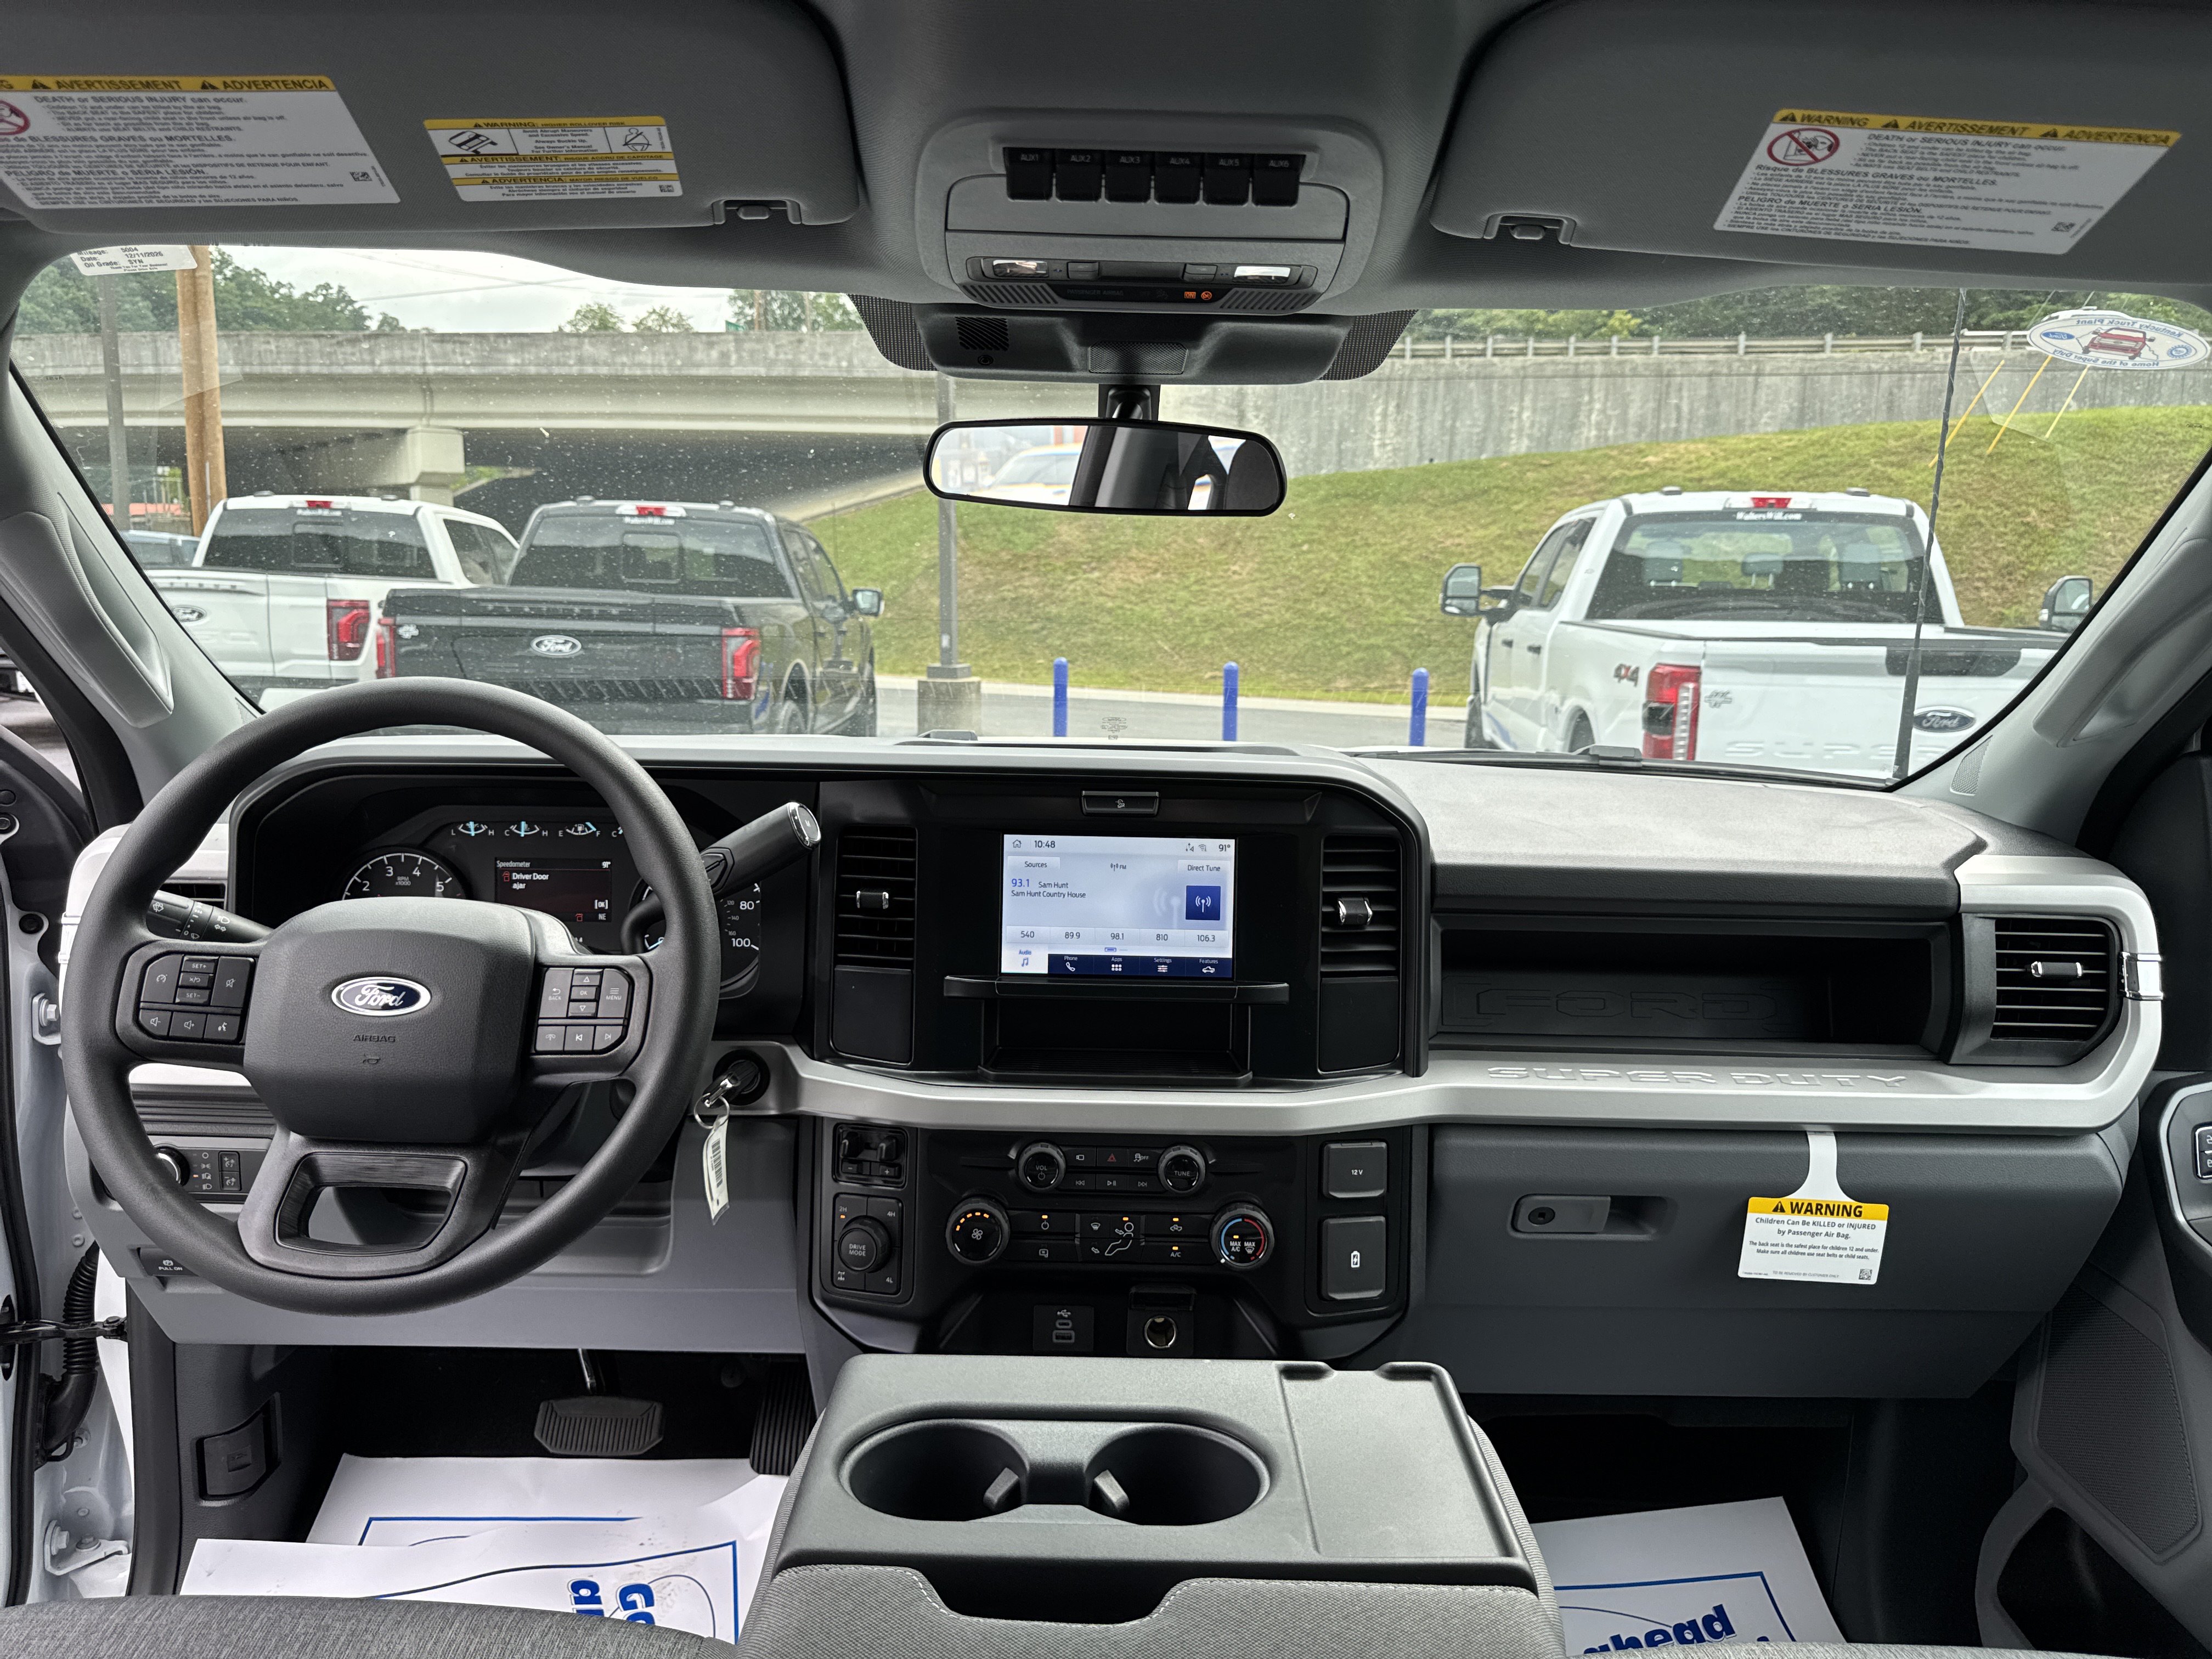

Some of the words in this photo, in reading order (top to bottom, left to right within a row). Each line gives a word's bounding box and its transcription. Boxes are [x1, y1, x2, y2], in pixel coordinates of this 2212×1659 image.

[57, 80, 182, 89] AVERTISSEMENT
[223, 80, 329, 89] ADVERTENCIA
[1800, 113, 1870, 127] WARNING
[1905, 120, 2029, 136] AVERTISSEMENT
[1034, 840, 1056, 848] 10:48
[386, 866, 393, 877] 3
[412, 867, 421, 877] 4
[362, 881, 370, 891] 2
[436, 882, 444, 892] 5
[1011, 878, 1030, 887] 93.1
[740, 901, 754, 910] 80
[731, 938, 751, 947] 100
[355, 984, 406, 1006] Ford
[1477, 989, 1776, 1021] FORD
[353, 1034, 396, 1042] AIRBAG
[1487, 1067, 1717, 1084] SUPER
[1731, 1072, 1907, 1087] DUTY
[1790, 1201, 1863, 1218] WARNING
[1755, 1217, 1785, 1225] Children
[1787, 1229, 1822, 1238] Passenger
